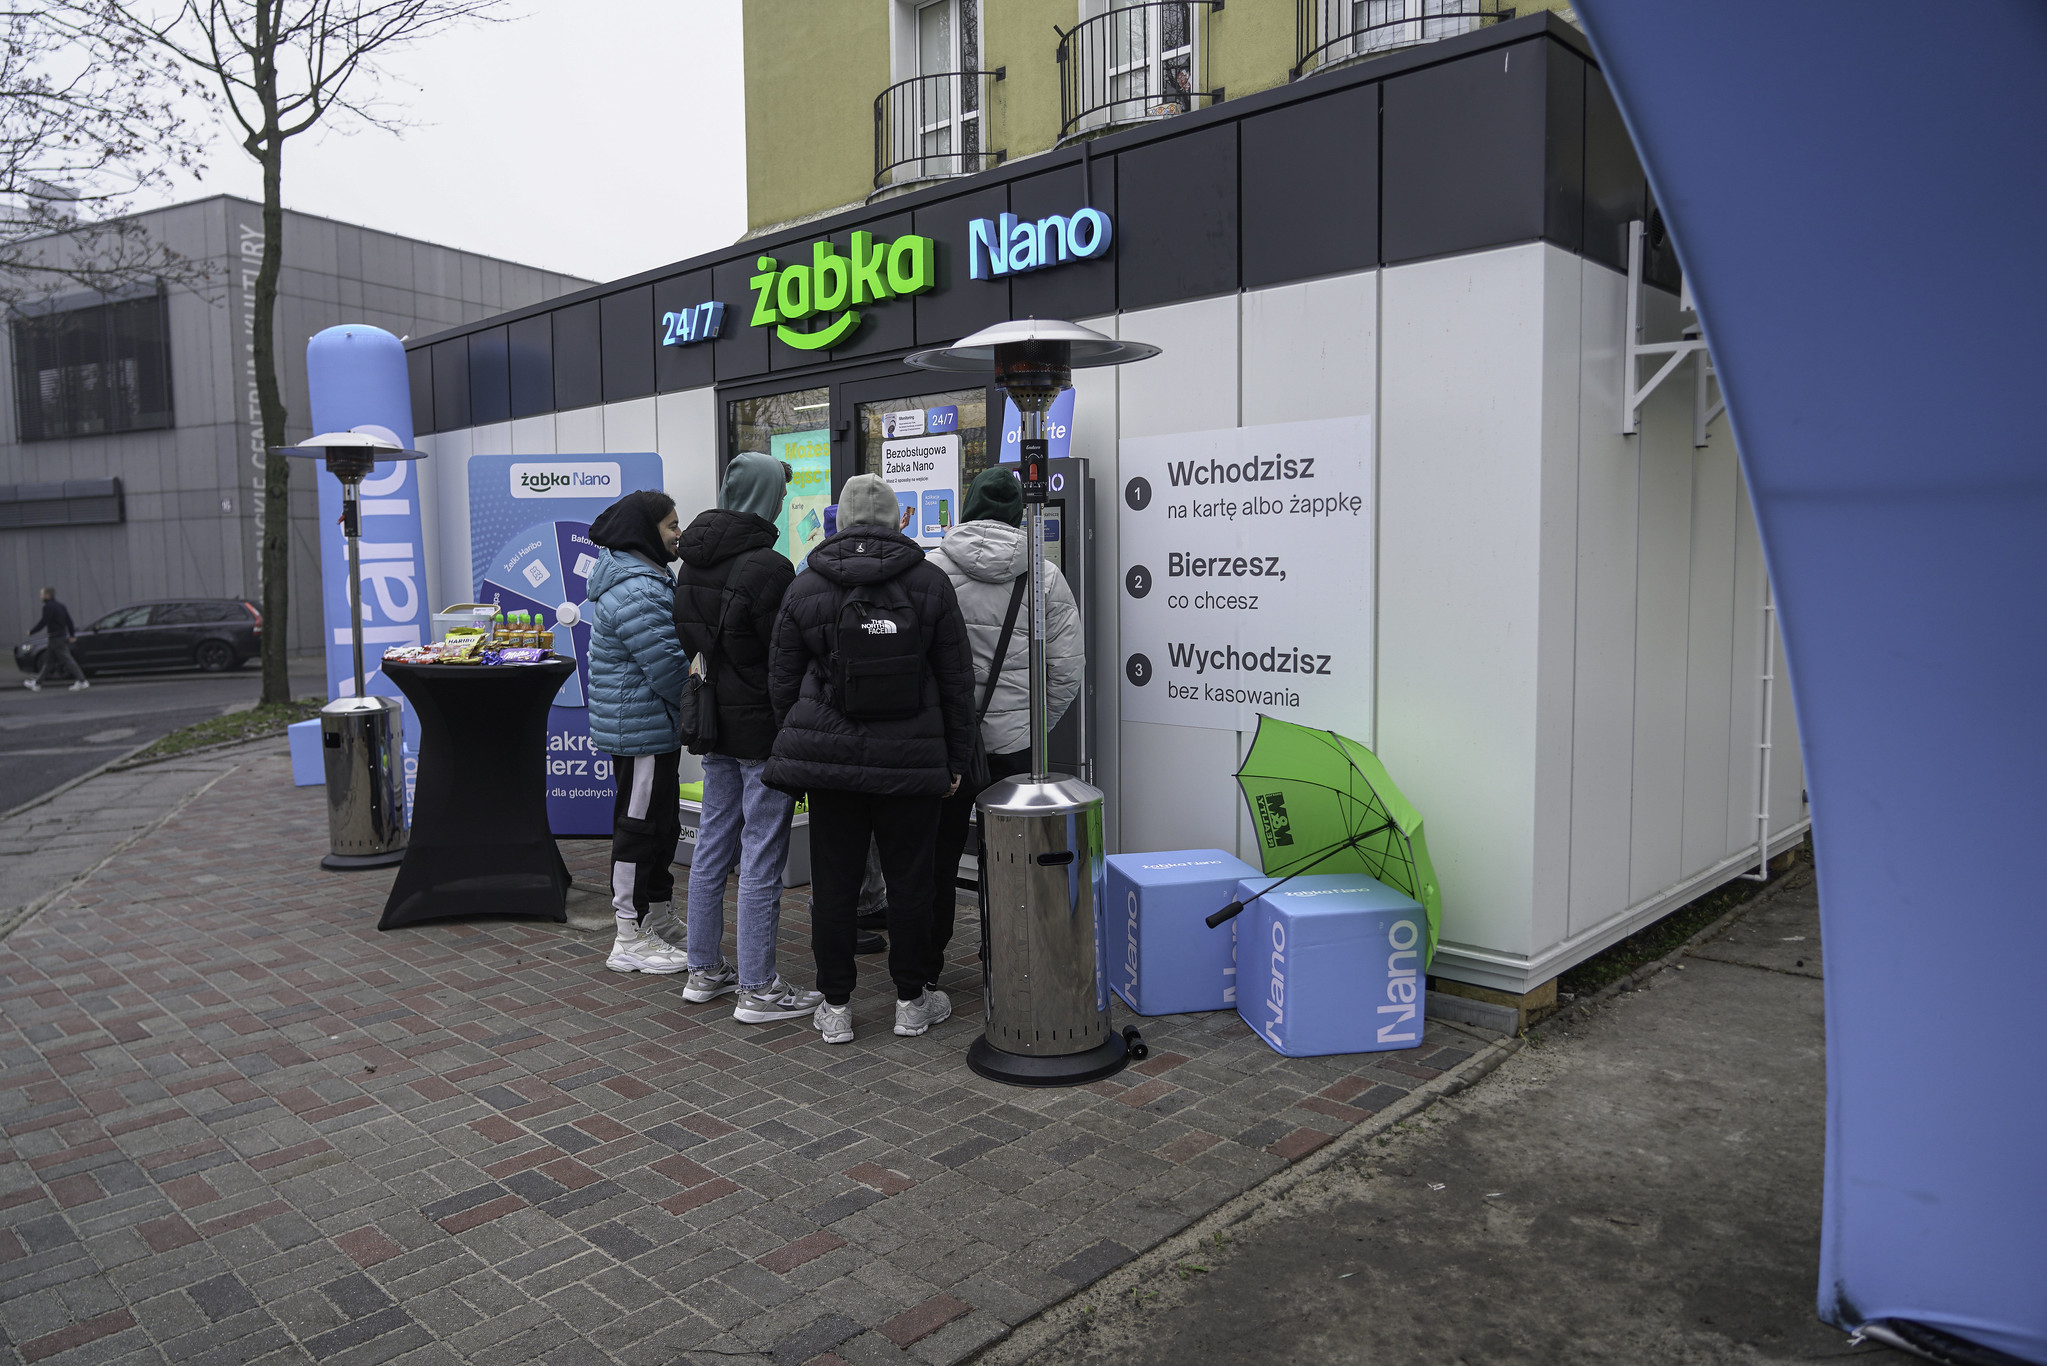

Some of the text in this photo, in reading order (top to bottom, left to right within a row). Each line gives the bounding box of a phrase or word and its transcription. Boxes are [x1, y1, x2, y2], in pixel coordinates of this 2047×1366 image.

[662, 207, 1114, 346] 24/7 żabka Nano
[932, 413, 954, 426] 24/7
[785, 441, 830, 460] Możes
[886, 446, 947, 460] Bezobsługowa
[787, 466, 821, 488] ejść
[886, 461, 935, 474] Żabka Nano
[1168, 453, 1315, 487] Wchodzisz
[521, 472, 611, 487] żabka Nano
[1134, 487, 1140, 500] 1
[1168, 492, 1362, 521] na kartę albo żappkę
[571, 534, 594, 547] Baton
[503, 540, 543, 573] Żelki Haribo
[1168, 552, 1286, 582] Bierzesz,
[1134, 575, 1142, 589] 2
[1168, 591, 1259, 610] co chcesz
[448, 637, 475, 645] HARIBO
[1168, 643, 1332, 676] Wychodzisz
[1135, 664, 1143, 677] 3
[1168, 681, 1300, 708] bez kasowania
[552, 788, 614, 799] dla głodnych
[1189, 859, 1222, 867] Nano
[1124, 890, 1138, 1007] Nano
[1265, 920, 1286, 1047] Nano
[1376, 919, 1419, 1043] Nano
